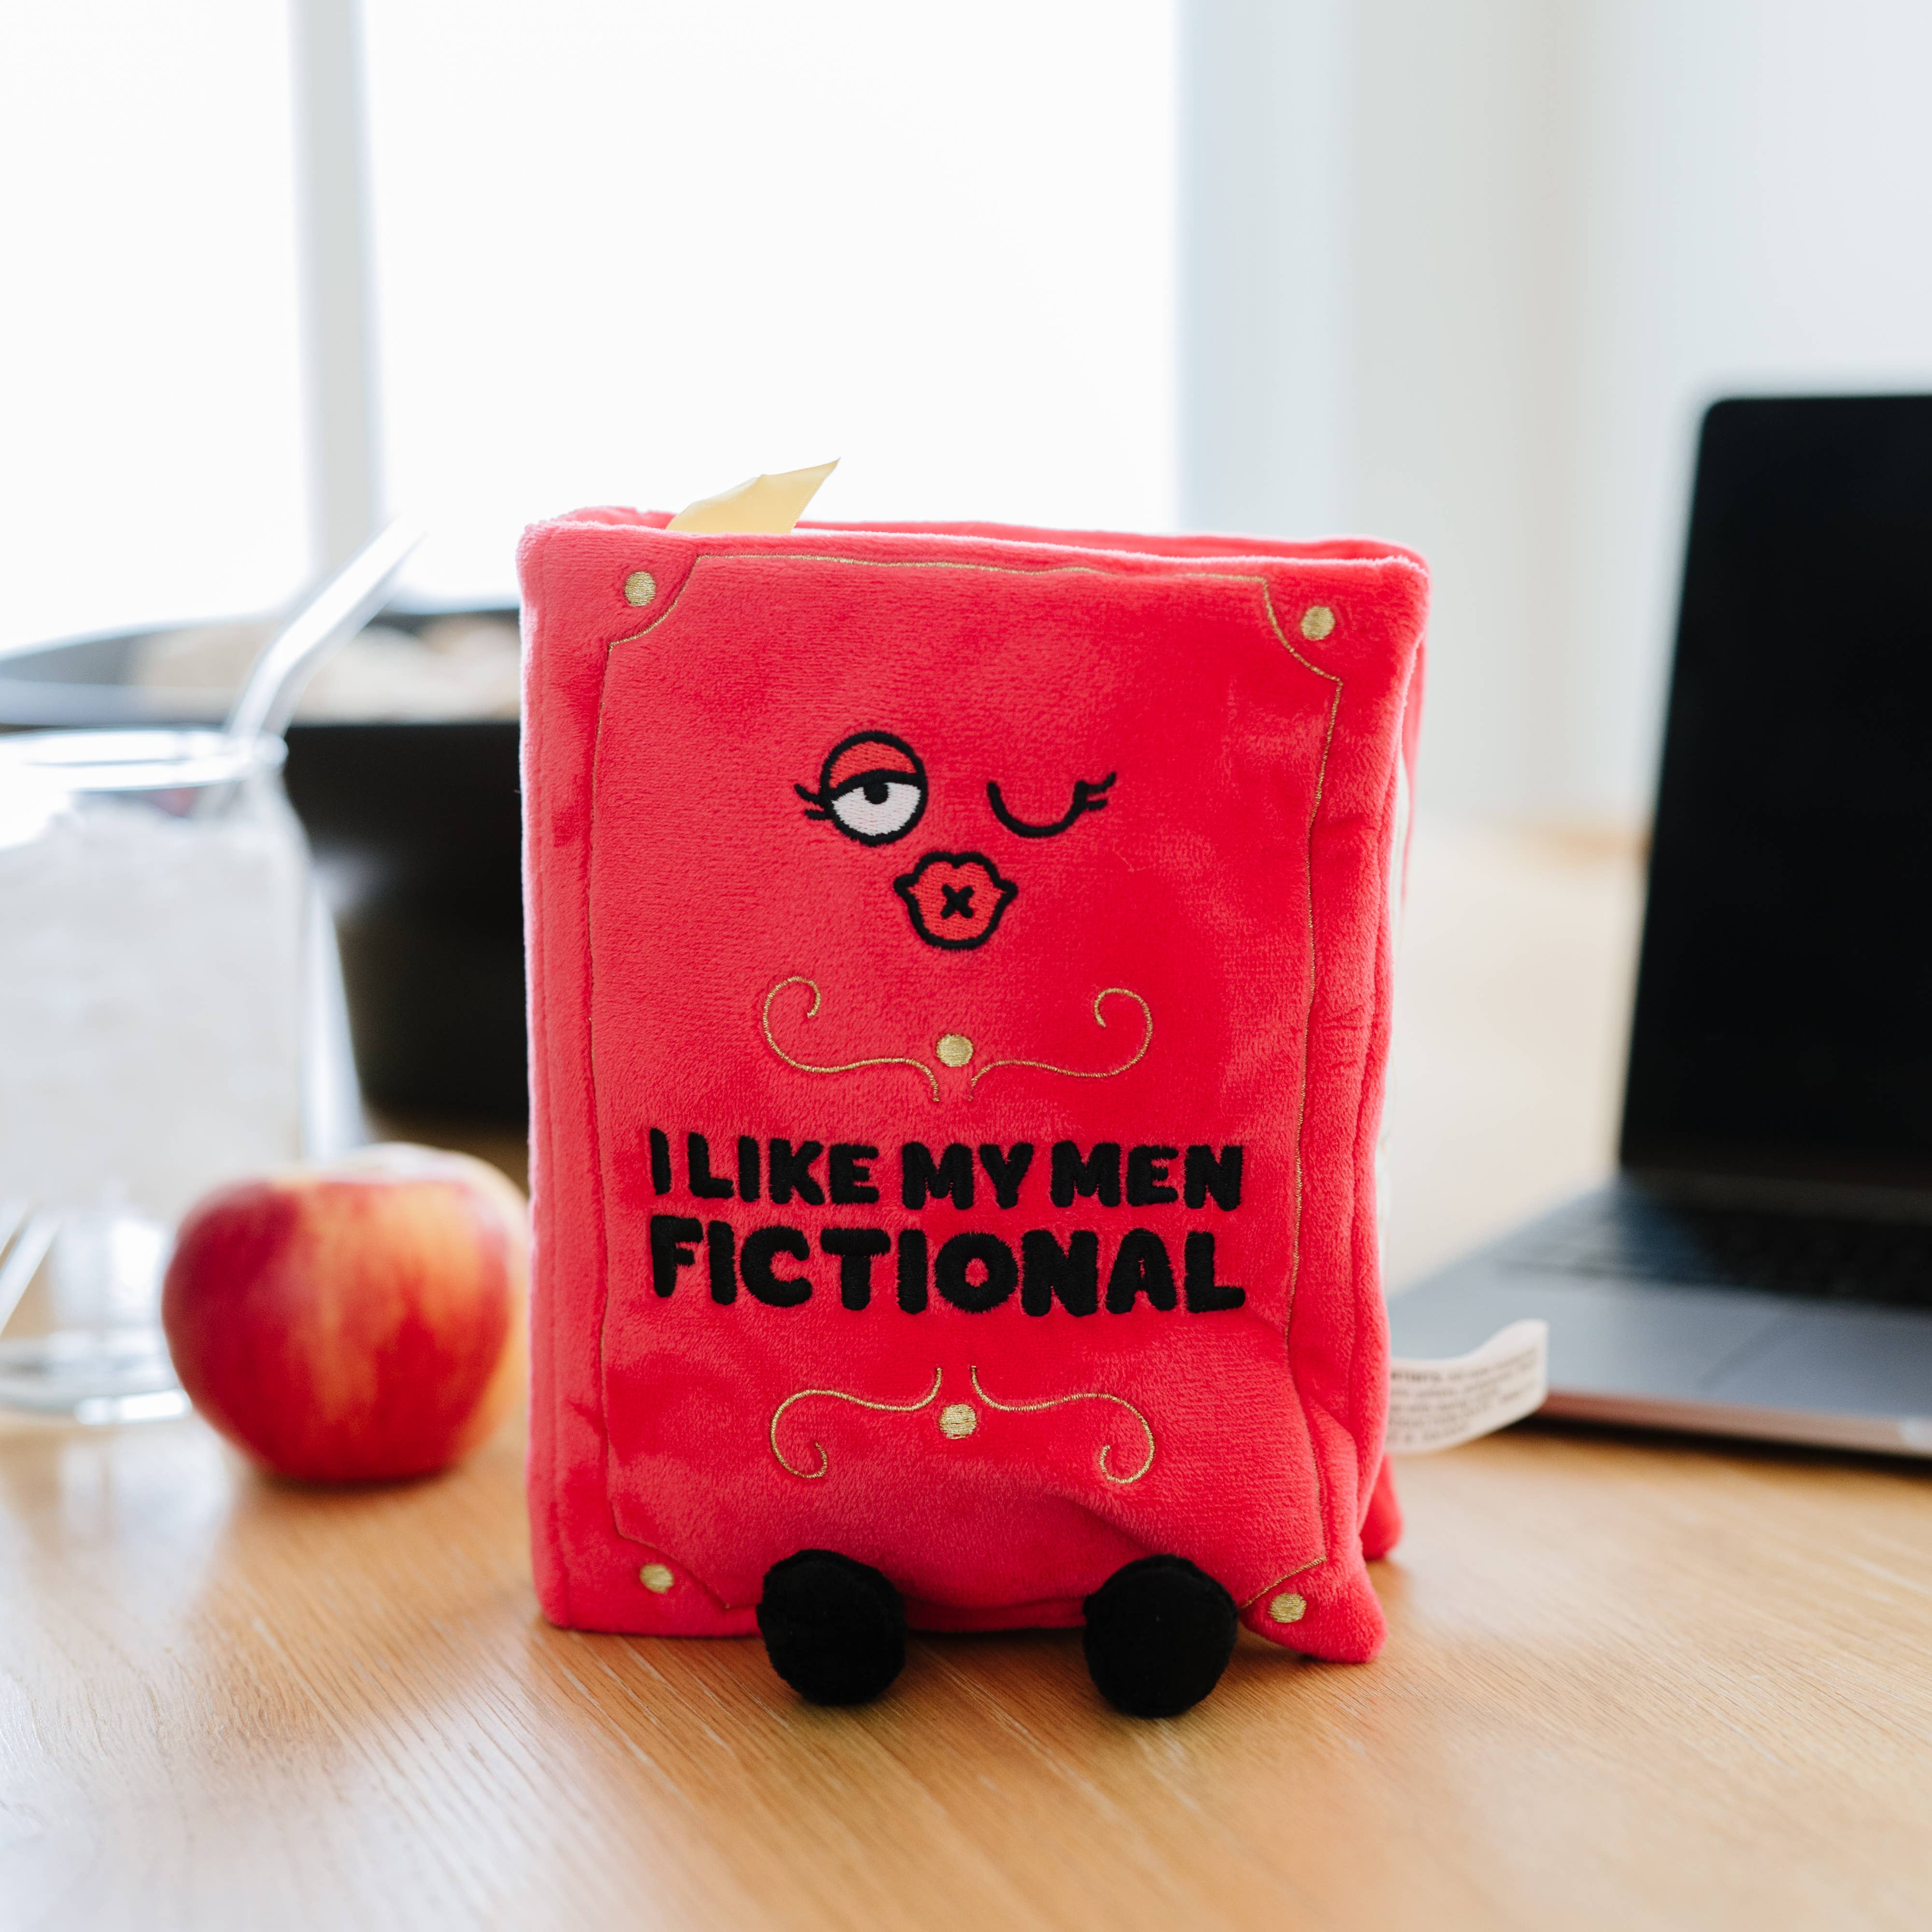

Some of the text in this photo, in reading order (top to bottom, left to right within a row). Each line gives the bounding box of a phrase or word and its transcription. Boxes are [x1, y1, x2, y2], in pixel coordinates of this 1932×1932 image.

[650, 1128, 1244, 1211] I LIKE MY MEN
[650, 1214, 1246, 1318] FICTIONAL
